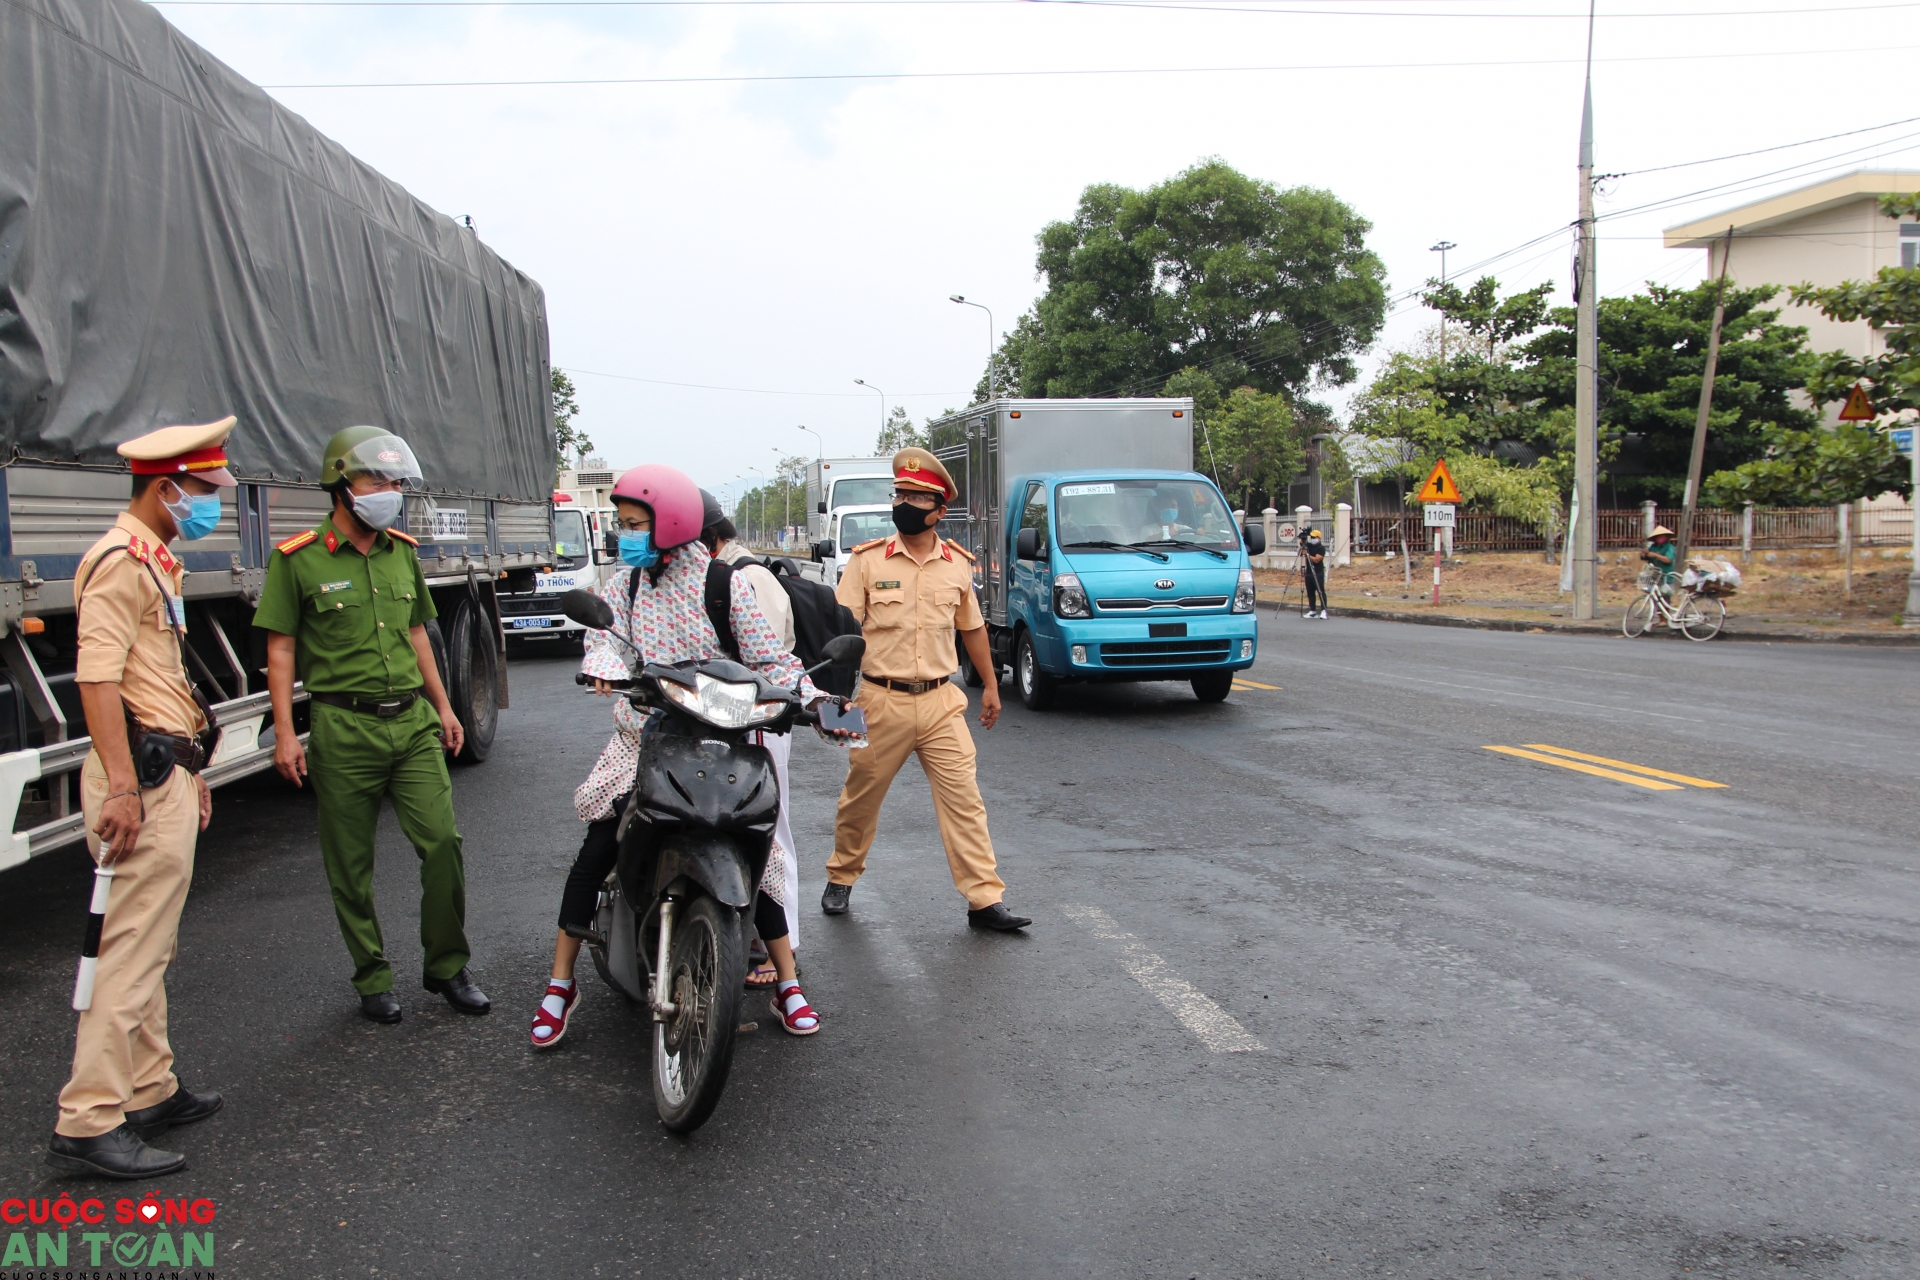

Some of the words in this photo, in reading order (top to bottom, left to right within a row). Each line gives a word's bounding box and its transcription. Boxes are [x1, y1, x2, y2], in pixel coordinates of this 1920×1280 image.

[1064, 487, 1080, 495] T92
[1427, 510, 1453, 521] 110m
[547, 577, 575, 587] THÔNG
[1157, 580, 1174, 588] KIA
[701, 739, 731, 749] HONDA
